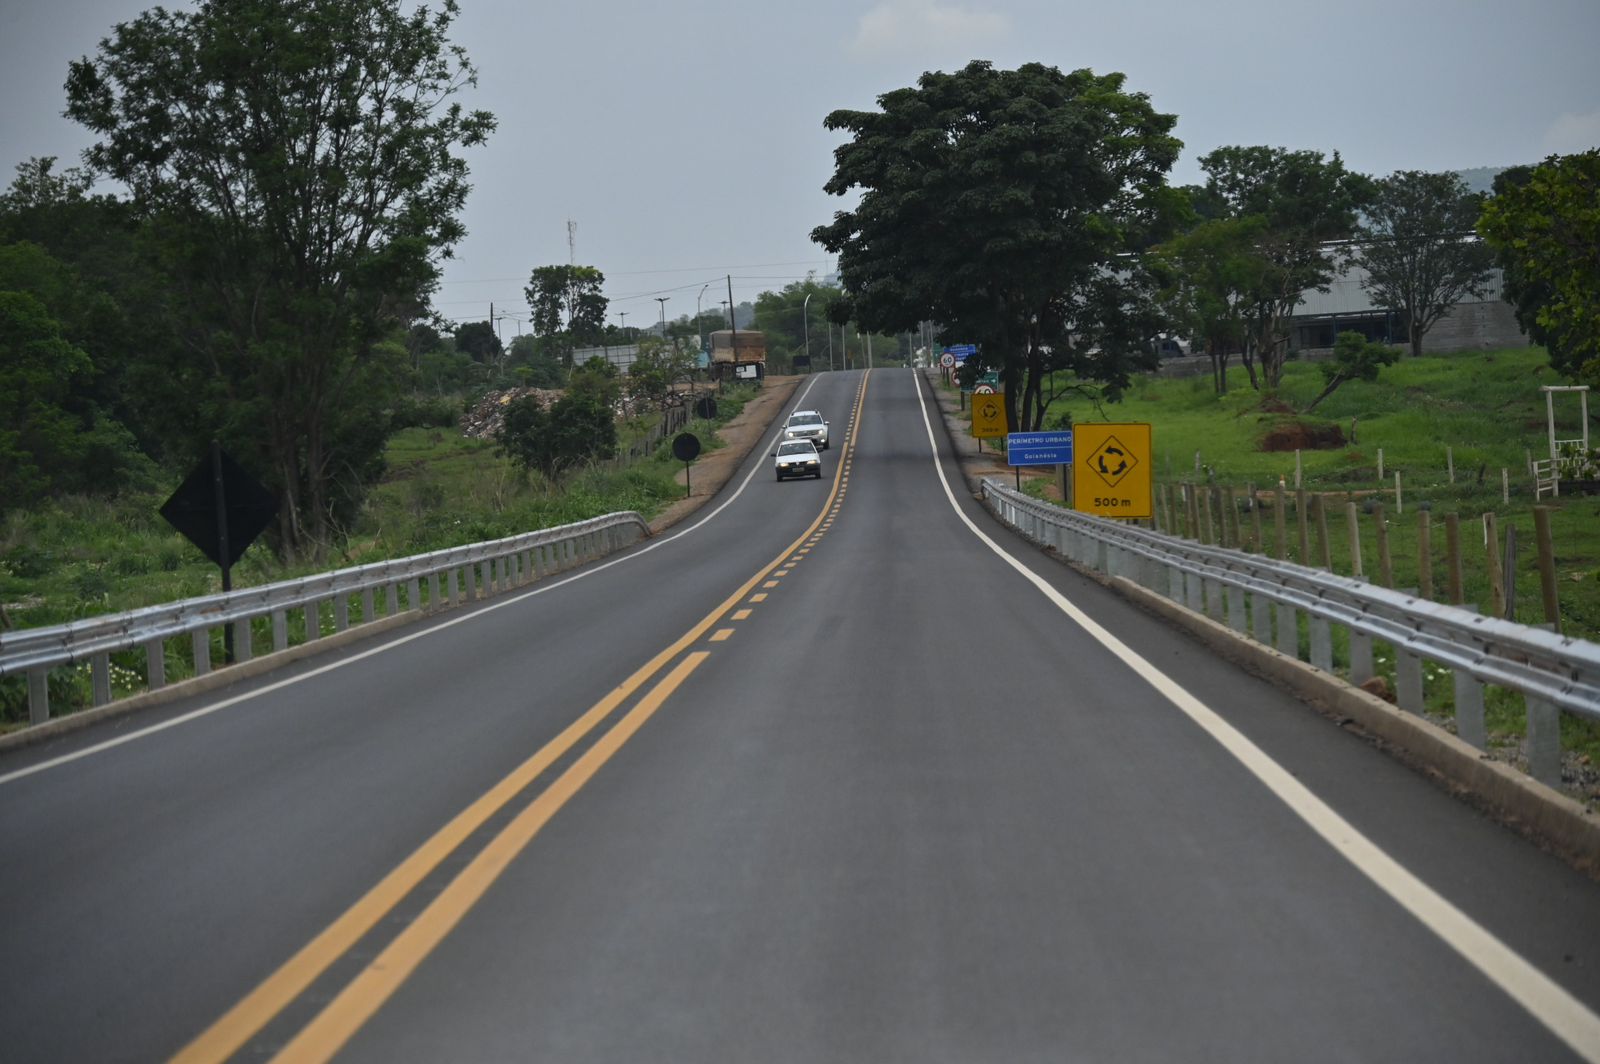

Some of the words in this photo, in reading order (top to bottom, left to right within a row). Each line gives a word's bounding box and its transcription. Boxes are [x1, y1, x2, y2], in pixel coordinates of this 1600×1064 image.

[943, 357, 952, 365] 60
[1094, 497, 1119, 507] 500
[1121, 499, 1131, 507] m
